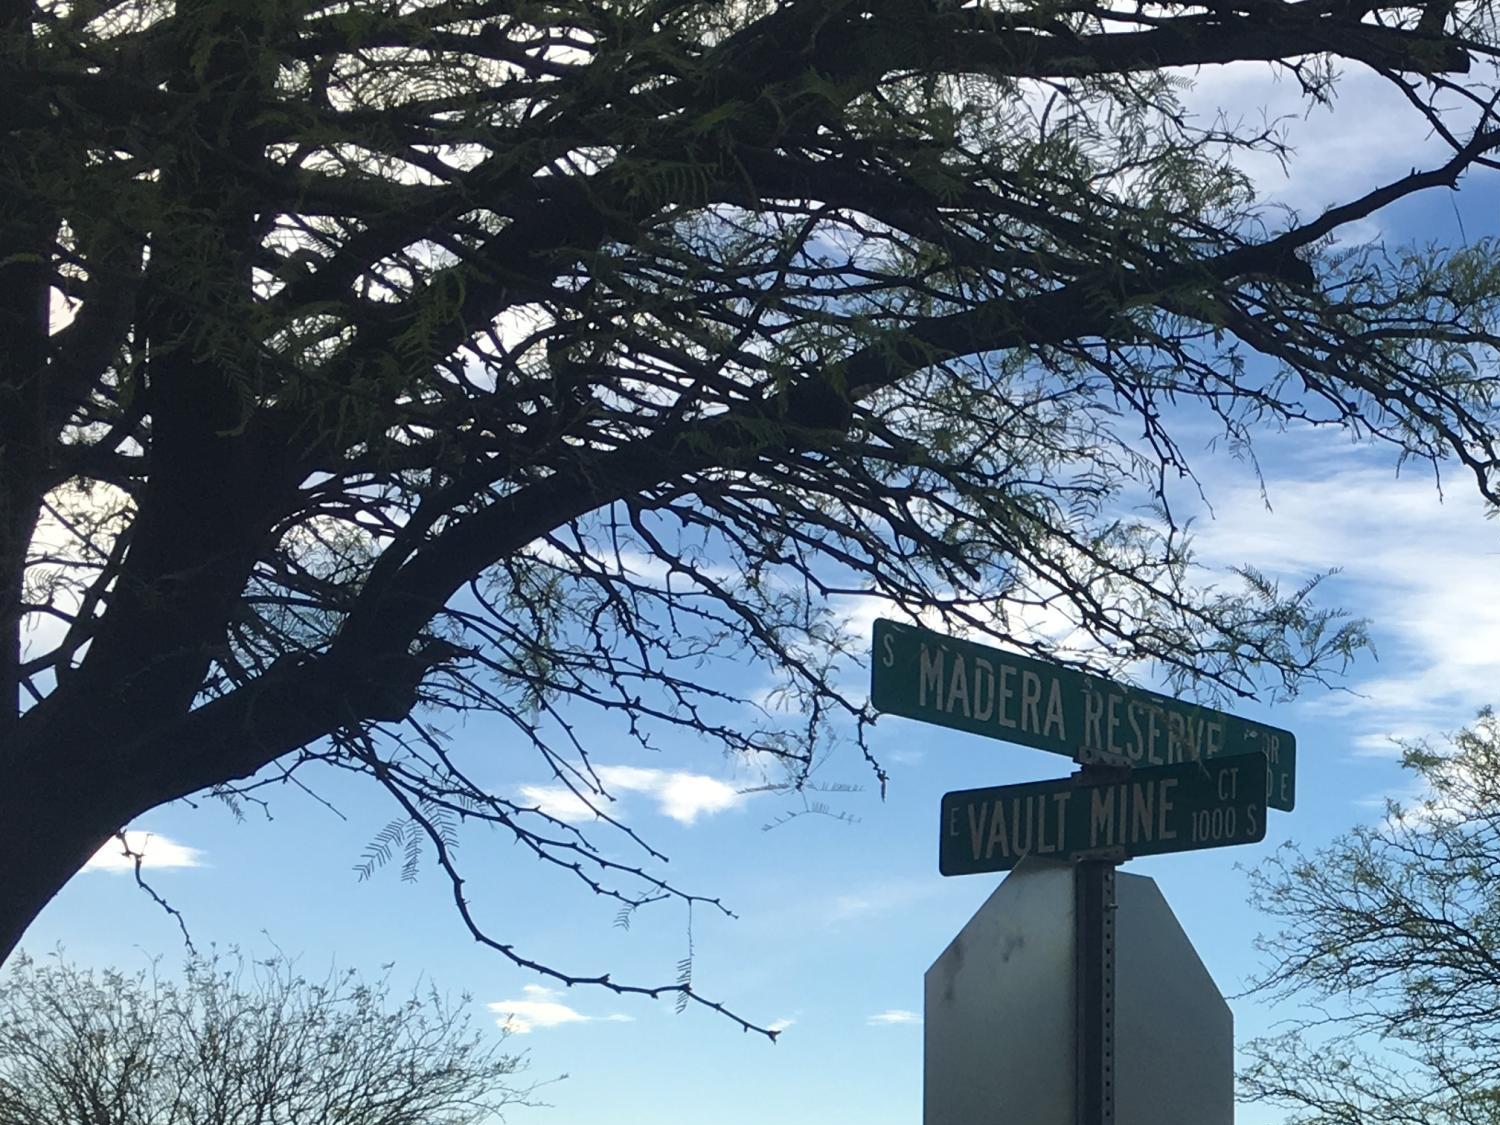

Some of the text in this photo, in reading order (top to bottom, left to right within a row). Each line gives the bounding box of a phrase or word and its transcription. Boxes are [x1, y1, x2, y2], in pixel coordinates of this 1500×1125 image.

[883, 633, 895, 668] S
[919, 643, 1066, 741] MADERA
[950, 806, 961, 837] E
[967, 792, 1072, 861] VAULT
[1089, 778, 1179, 848] MINE
[1218, 767, 1239, 801] CT
[1281, 772, 1289, 802] E
[1191, 804, 1258, 841] 1000 S
